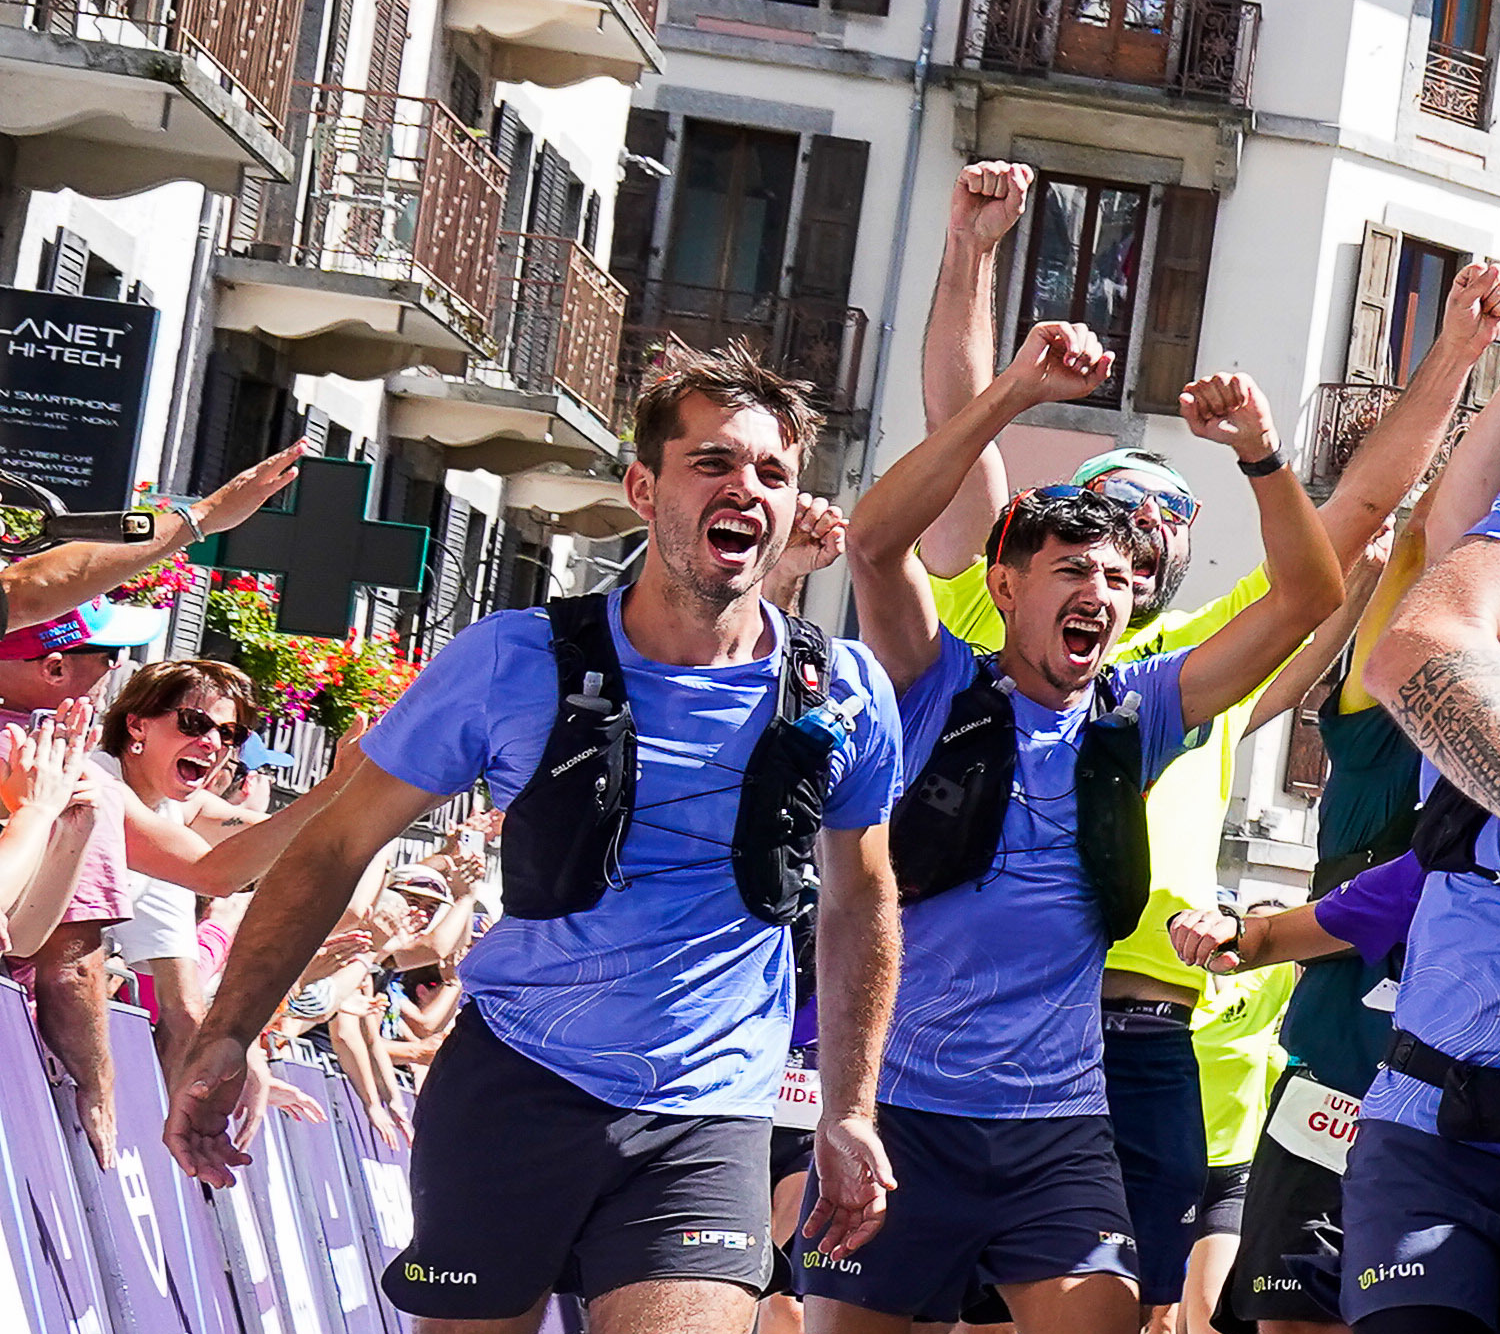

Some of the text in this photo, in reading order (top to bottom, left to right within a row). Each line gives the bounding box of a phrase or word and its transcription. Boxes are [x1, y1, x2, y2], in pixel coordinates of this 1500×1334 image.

[8, 340, 122, 370] HI-TECH
[551, 746, 599, 778] SALOMON
[429, 1266, 477, 1284] i-run
[1379, 1262, 1426, 1282] i-run
[1267, 1275, 1302, 1291] i-run
